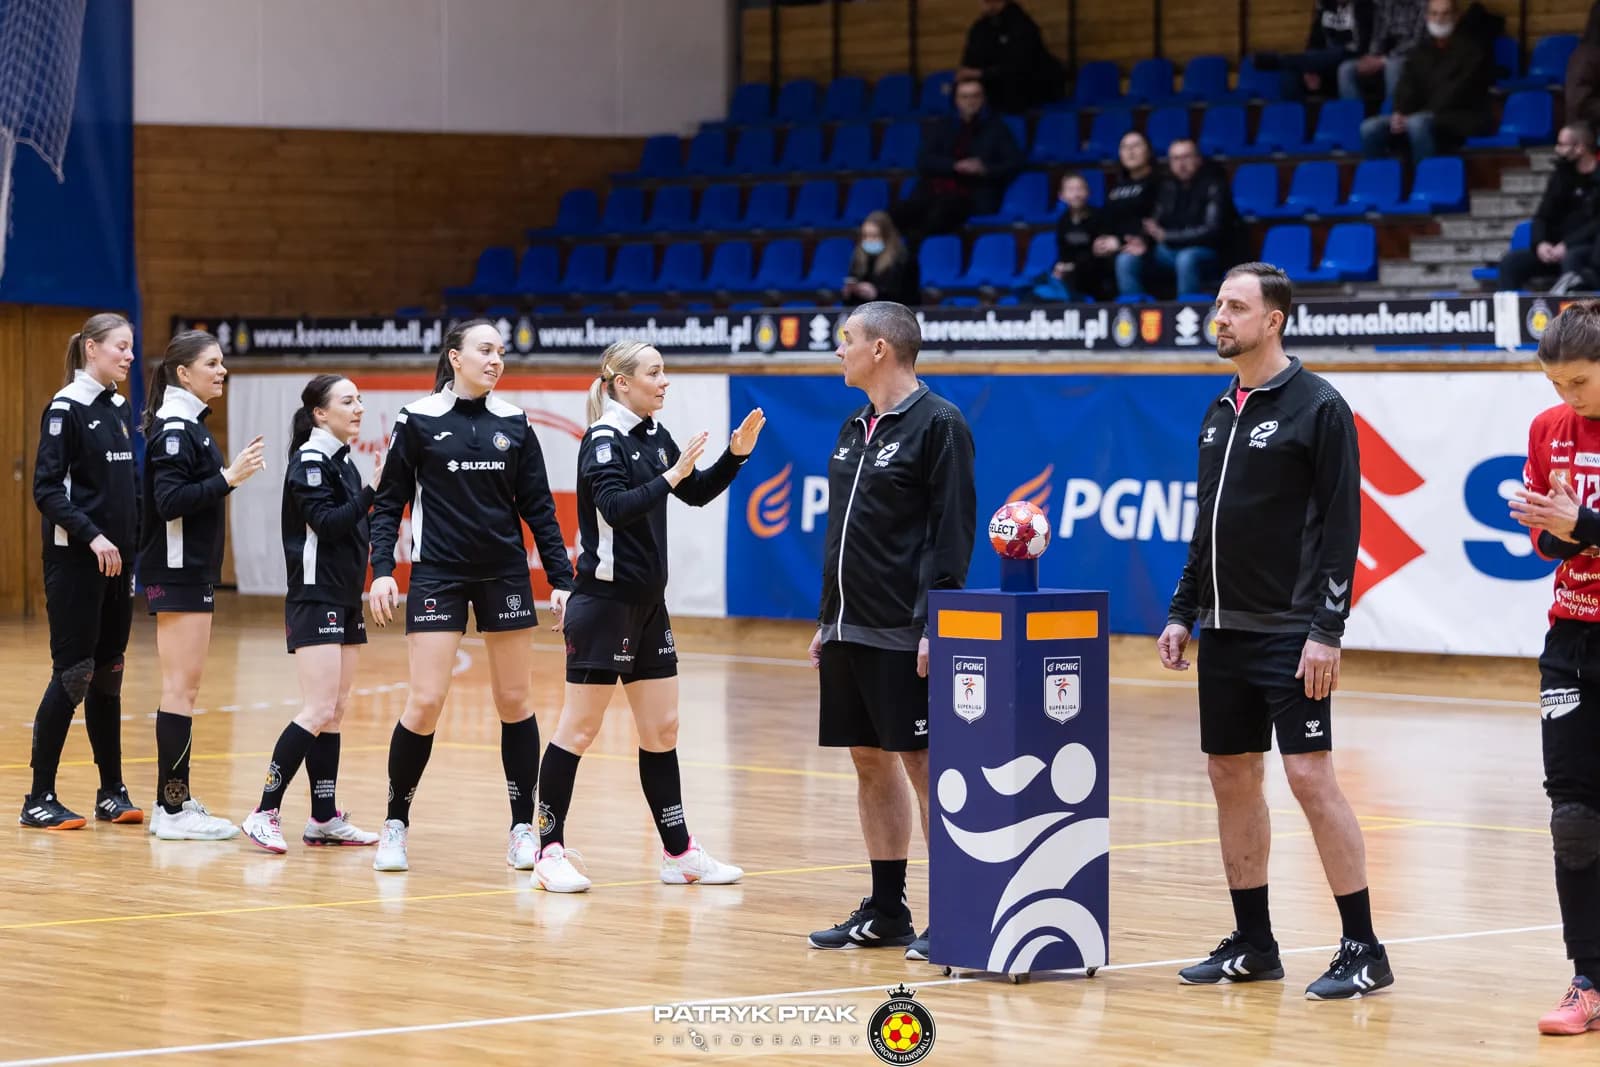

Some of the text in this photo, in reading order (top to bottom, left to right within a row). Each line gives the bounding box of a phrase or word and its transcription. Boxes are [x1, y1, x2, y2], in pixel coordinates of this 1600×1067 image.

[461, 461, 505, 471] SUZUKI
[1574, 472, 1600, 512] 12
[498, 609, 531, 620] PROFIKA
[1055, 662, 1079, 671] PGNiG
